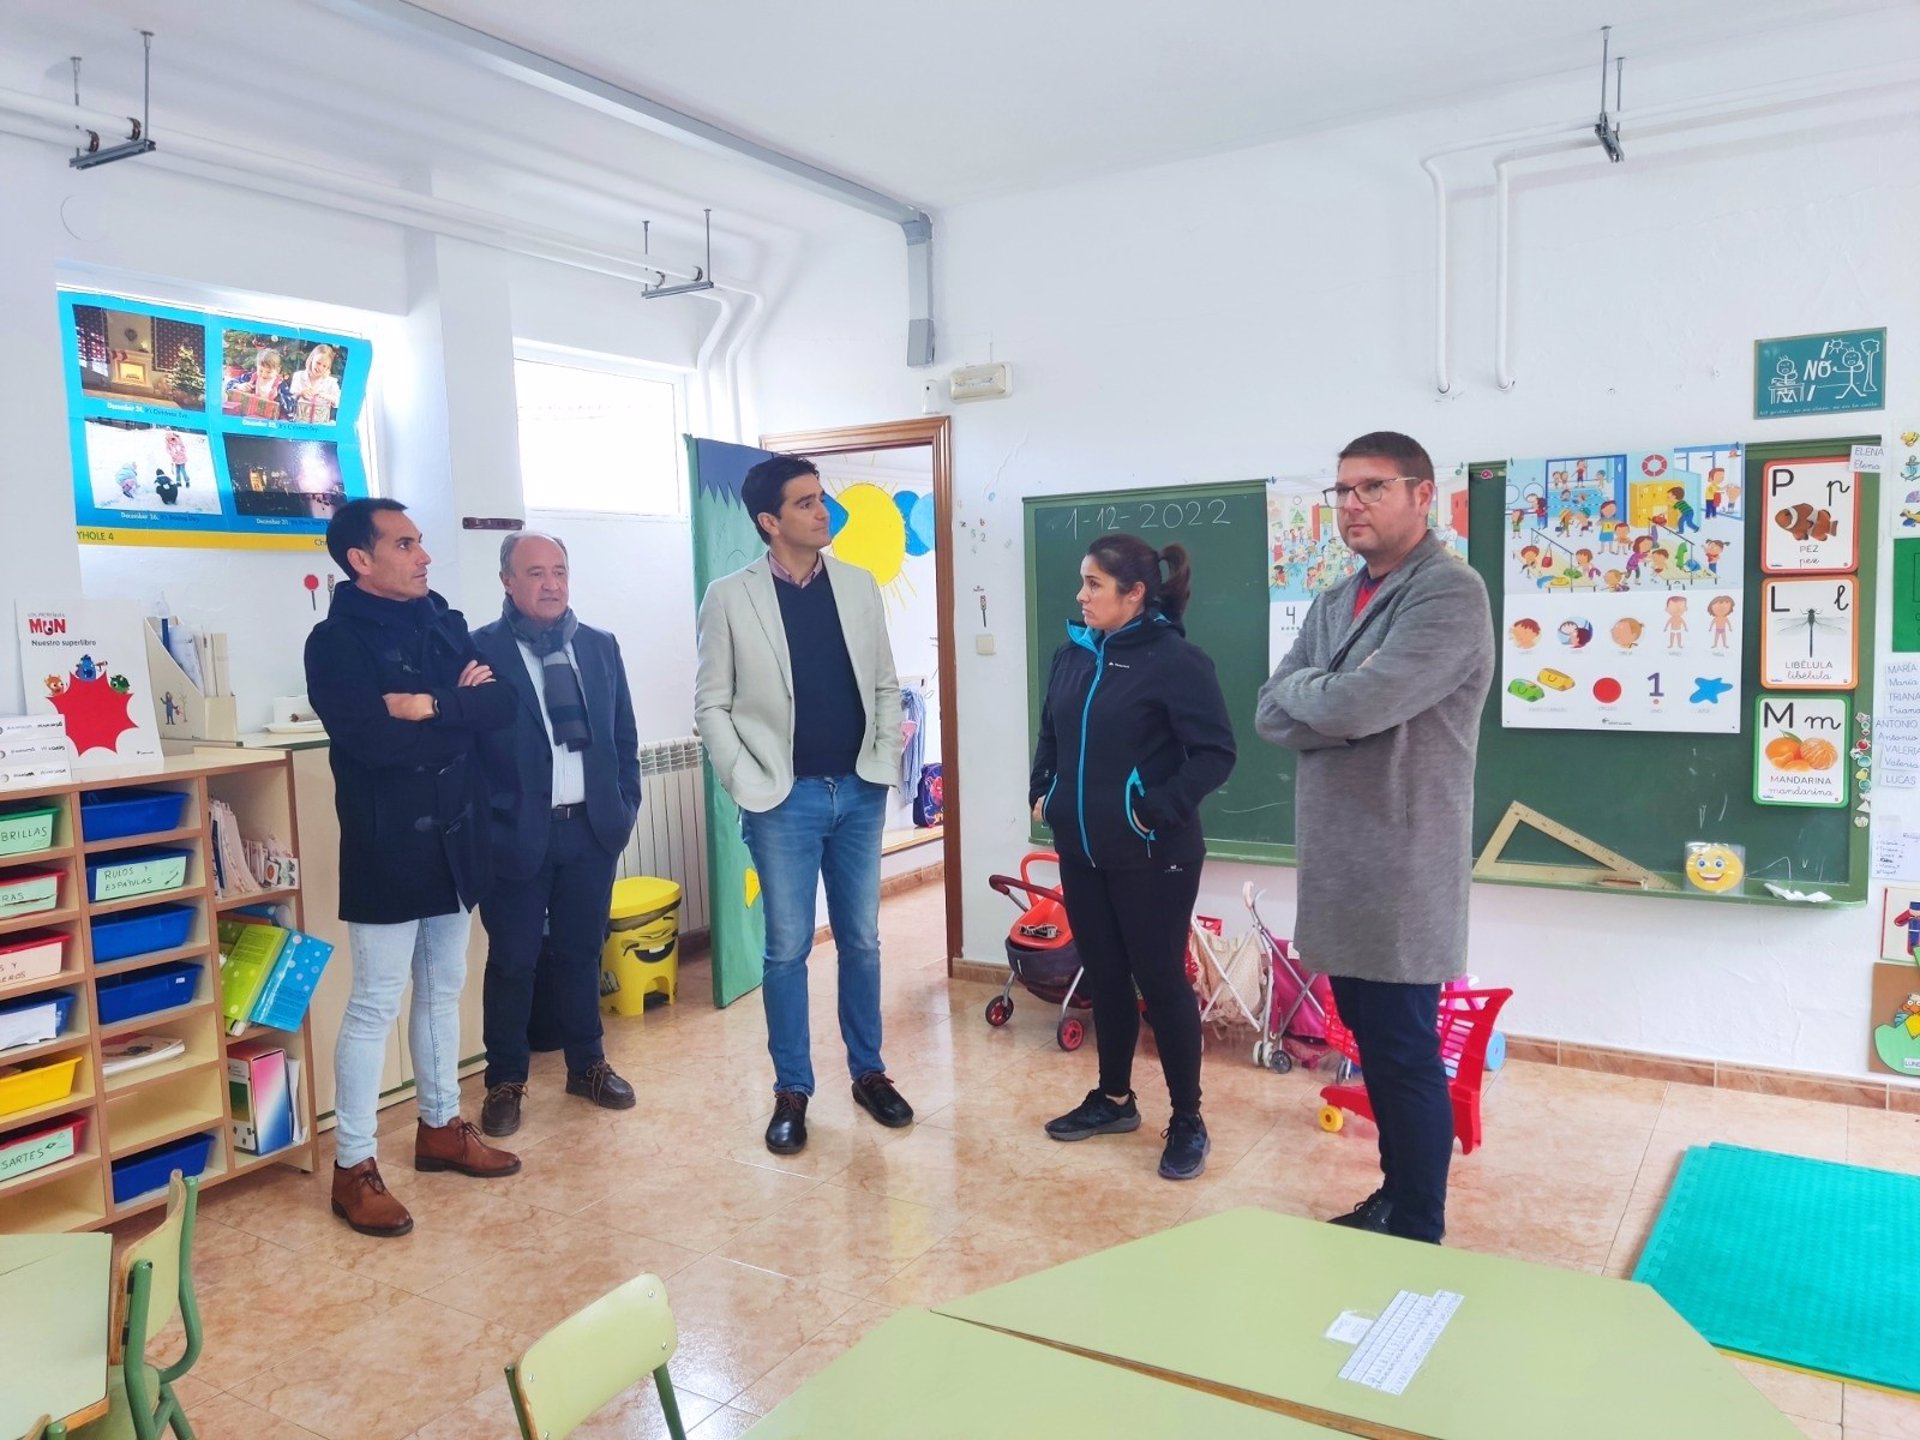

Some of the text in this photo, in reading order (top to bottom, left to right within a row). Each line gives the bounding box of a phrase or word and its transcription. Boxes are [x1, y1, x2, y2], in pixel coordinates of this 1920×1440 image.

[1804, 360, 1832, 381] NO
[1855, 447, 1884, 457] ELENA
[1772, 468, 1794, 497] P
[108, 533, 114, 541] 4
[1800, 545, 1819, 553] PEZ
[1771, 585, 1791, 612] L
[1286, 606, 1296, 625] 4
[62, 639, 96, 647] superlibro
[1785, 660, 1833, 669] LIBÉLULA
[1888, 663, 1917, 673] MARÍA
[1647, 672, 1664, 697] 1
[1764, 702, 1841, 730] M m
[1875, 720, 1917, 729] ANTONIO
[1770, 775, 1831, 784] MANDARINA
[1885, 775, 1916, 785] LUCAS
[1769, 786, 1833, 796] mandarina
[104, 866, 134, 880] RULOS
[1, 1148, 44, 1170] SARTES
